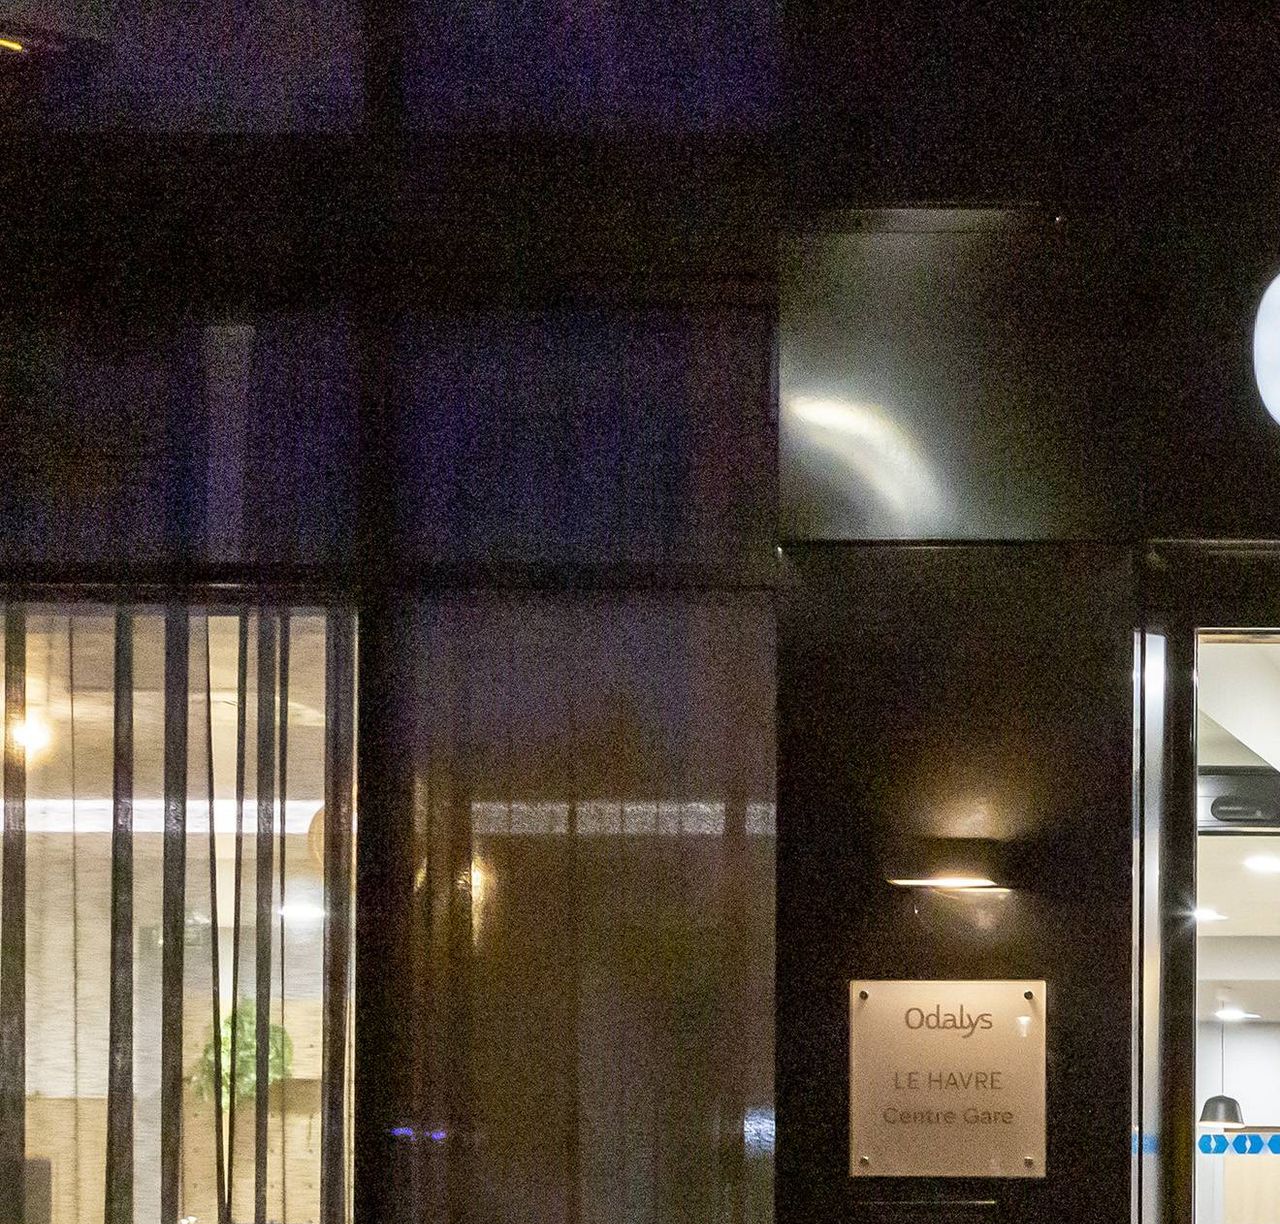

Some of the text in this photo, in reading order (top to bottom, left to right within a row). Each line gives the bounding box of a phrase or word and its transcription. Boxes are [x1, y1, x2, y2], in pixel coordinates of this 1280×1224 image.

[904, 1004, 993, 1039] Odalys
[893, 1071, 1003, 1091] LE HAVRE
[882, 1106, 1014, 1125] Centre Gare
